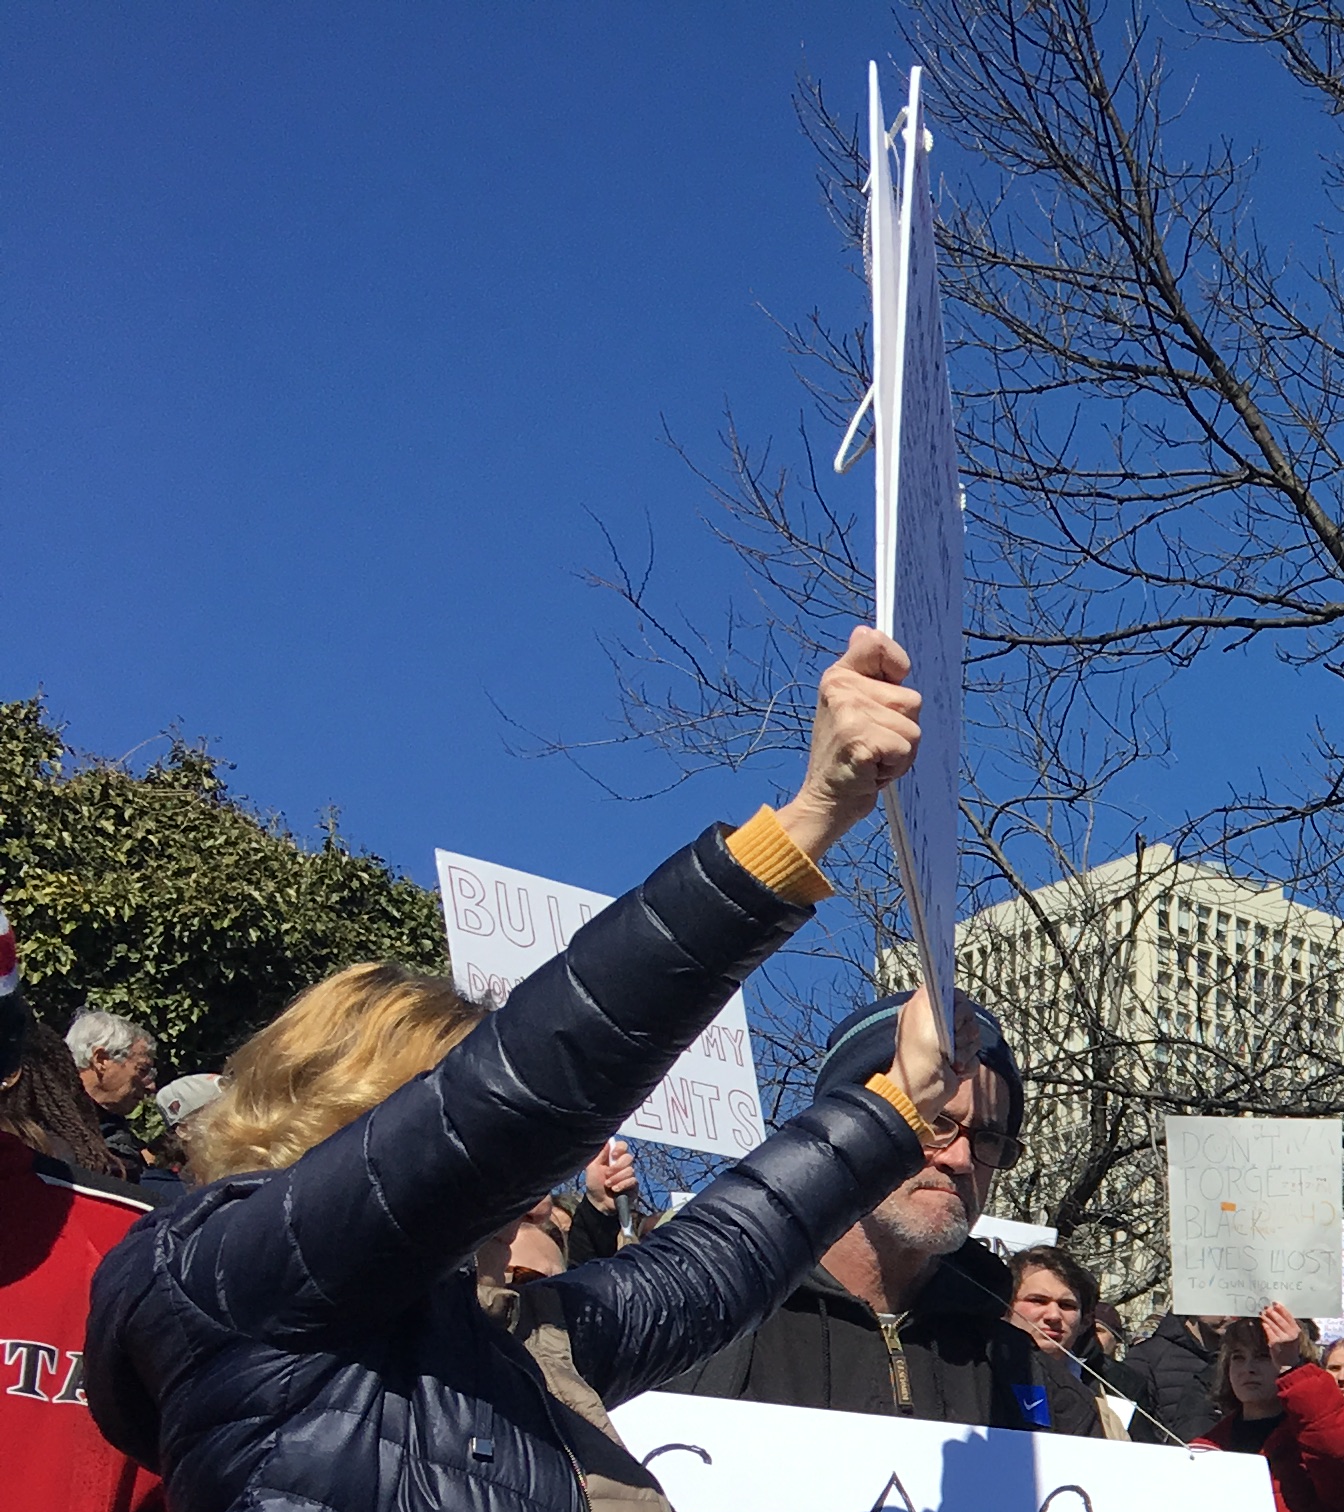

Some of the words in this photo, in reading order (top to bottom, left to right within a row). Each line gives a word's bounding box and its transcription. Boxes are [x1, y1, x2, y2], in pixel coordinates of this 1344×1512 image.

[1182, 1130, 1281, 1163] DON'T
[1182, 1166, 1309, 1200] FORGET
[1184, 1204, 1267, 1240] BLACK
[1184, 1246, 1259, 1271] LIVES
[1270, 1250, 1336, 1275] LOST
[1218, 1280, 1245, 1290] GUN
[1250, 1280, 1303, 1291] VIOLENCE
